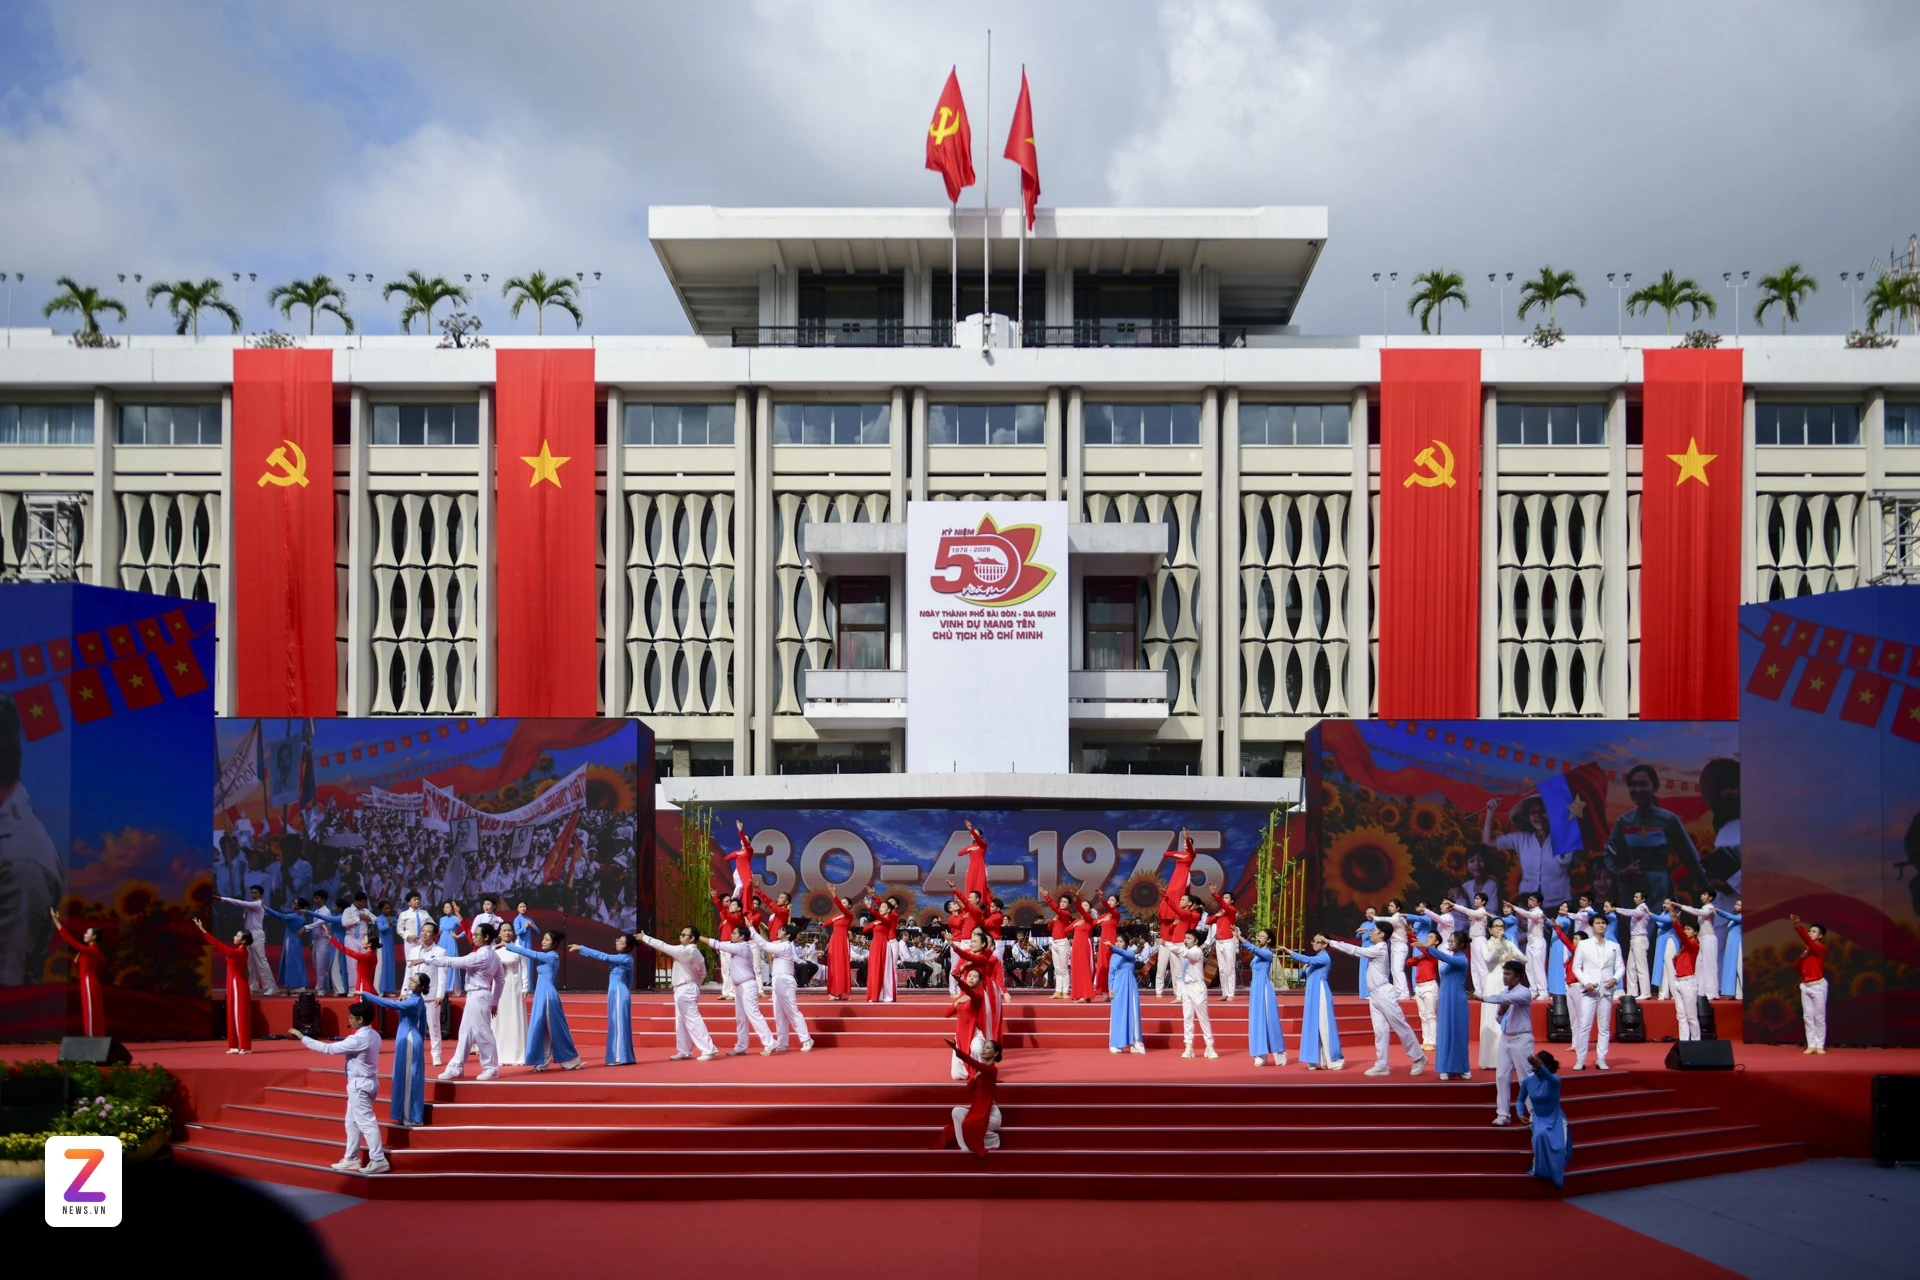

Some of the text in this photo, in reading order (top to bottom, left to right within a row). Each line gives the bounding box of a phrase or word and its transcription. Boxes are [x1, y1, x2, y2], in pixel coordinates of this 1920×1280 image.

[919, 610, 940, 618] NGÀY
[942, 610, 967, 618] THÀNH
[969, 608, 985, 618] PHỐ
[987, 610, 998, 618] SÀI
[1001, 610, 1017, 618] GÒN
[1037, 610, 1056, 619] ĐỊNH
[940, 618, 1036, 630] VINH DỰ MANG TÊN
[932, 629, 1043, 641] CHỦ TỊCH HỒ CHÍ MINH
